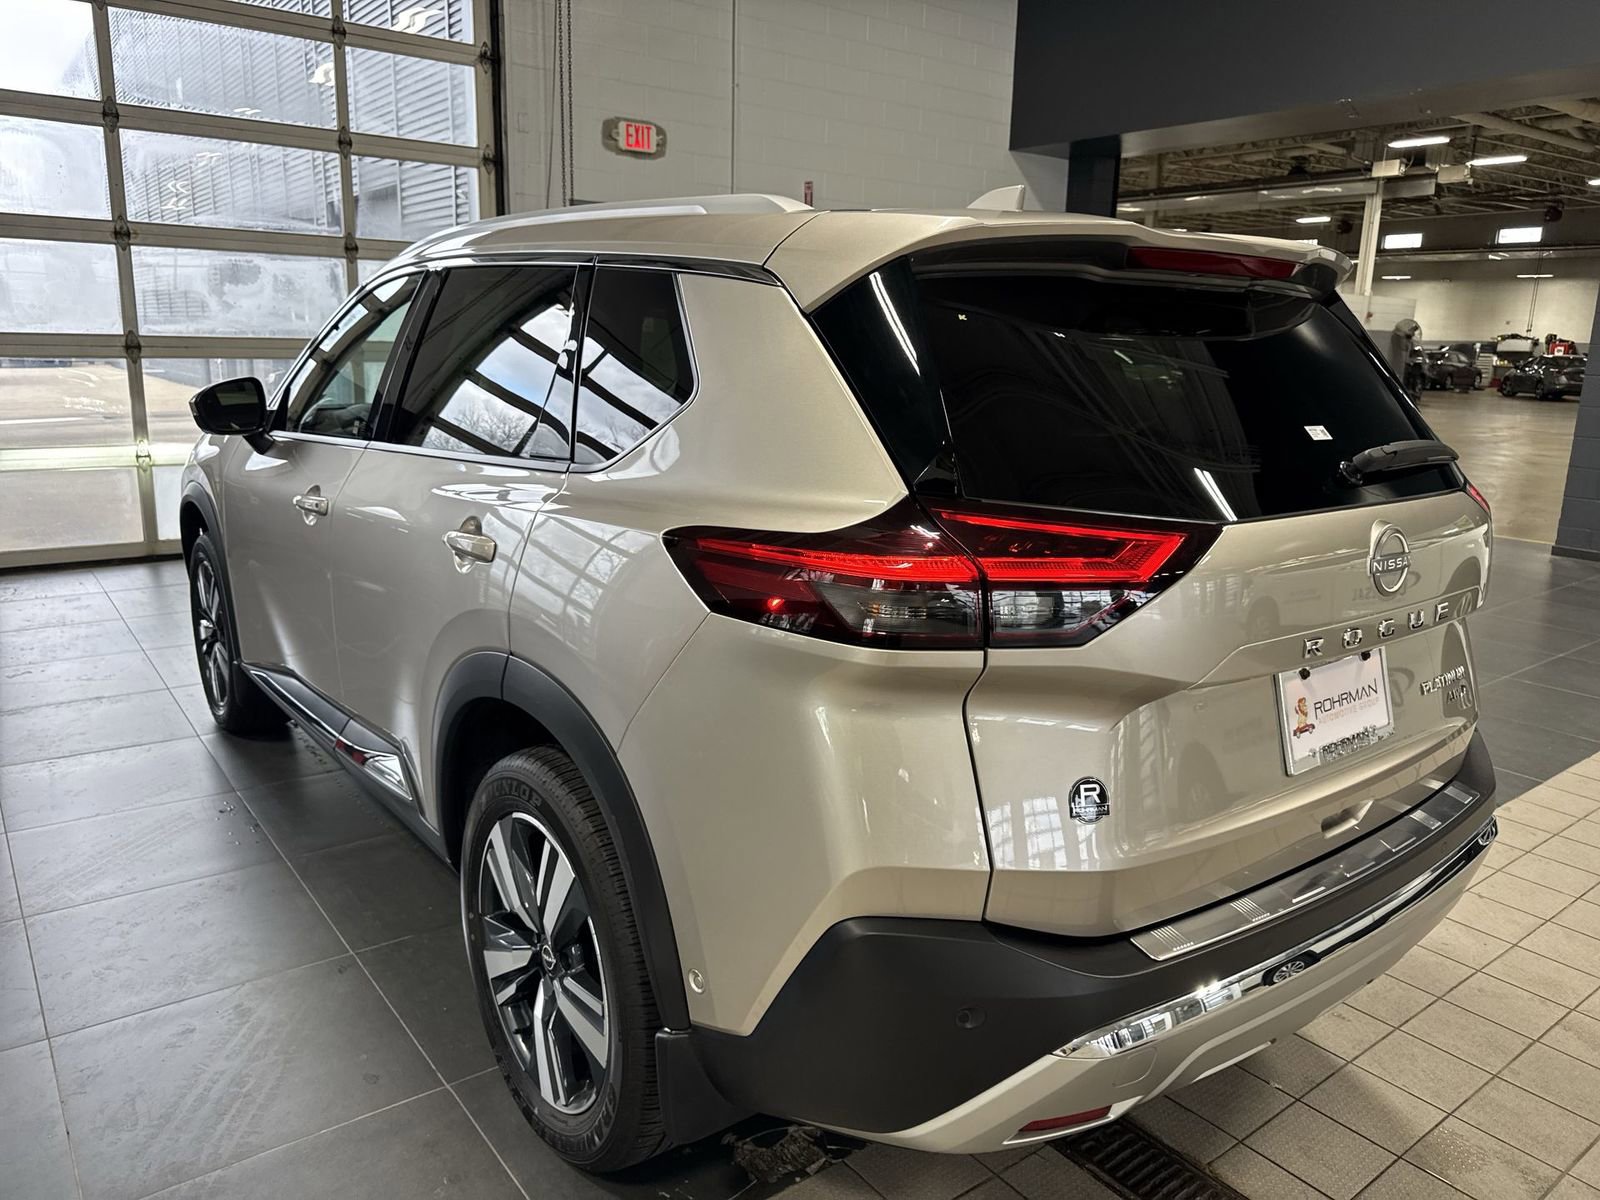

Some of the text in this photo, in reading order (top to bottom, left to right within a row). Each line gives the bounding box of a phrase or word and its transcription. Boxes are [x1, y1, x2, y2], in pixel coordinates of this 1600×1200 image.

[625, 123, 652, 150] EXIT
[1303, 602, 1449, 659] ROGUE
[1420, 665, 1466, 695] PLATINUM
[1313, 678, 1378, 720] ROHRMAN
[1080, 784, 1101, 807] R
